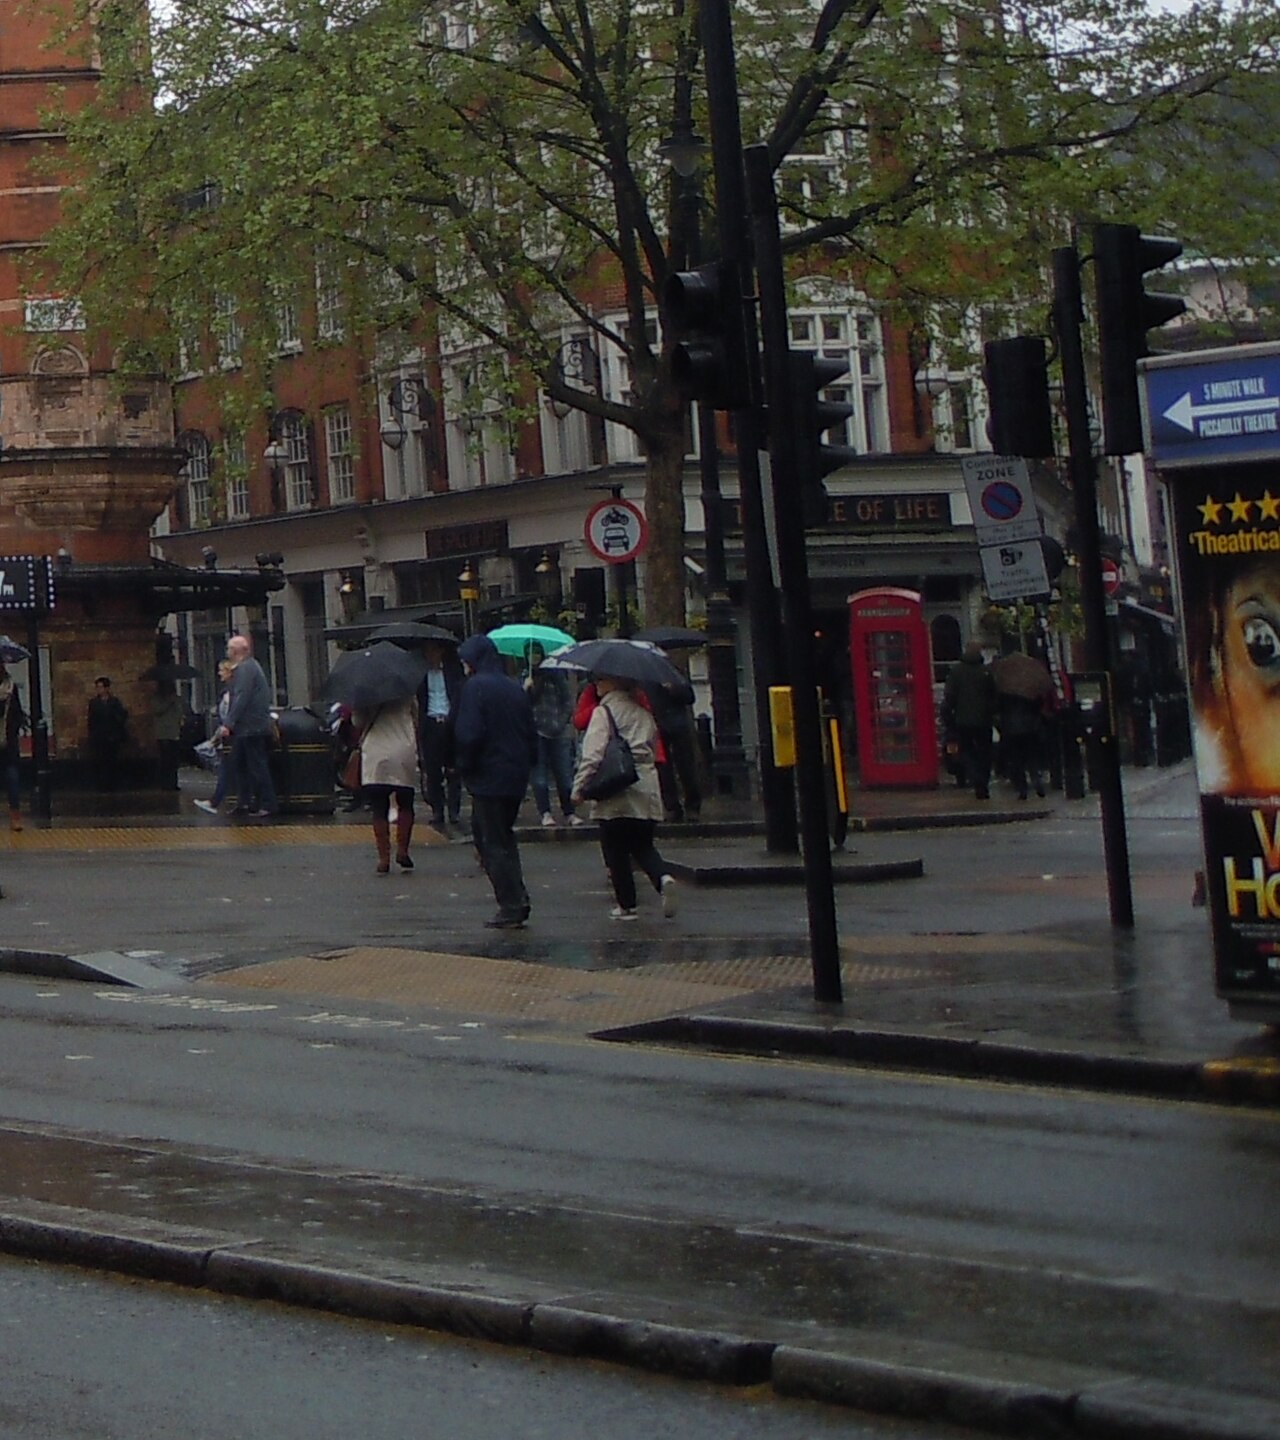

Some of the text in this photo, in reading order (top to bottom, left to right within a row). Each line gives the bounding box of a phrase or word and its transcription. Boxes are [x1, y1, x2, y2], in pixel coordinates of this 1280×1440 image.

[1203, 376, 1266, 401] 5 MINUTE WALK
[1199, 412, 1279, 438] PICCADILLY THEATRE
[977, 466, 1017, 481] ZONE
[856, 500, 884, 521] OF
[894, 498, 940, 520] LIFE
[1188, 526, 1280, 556] 'Theatrica
